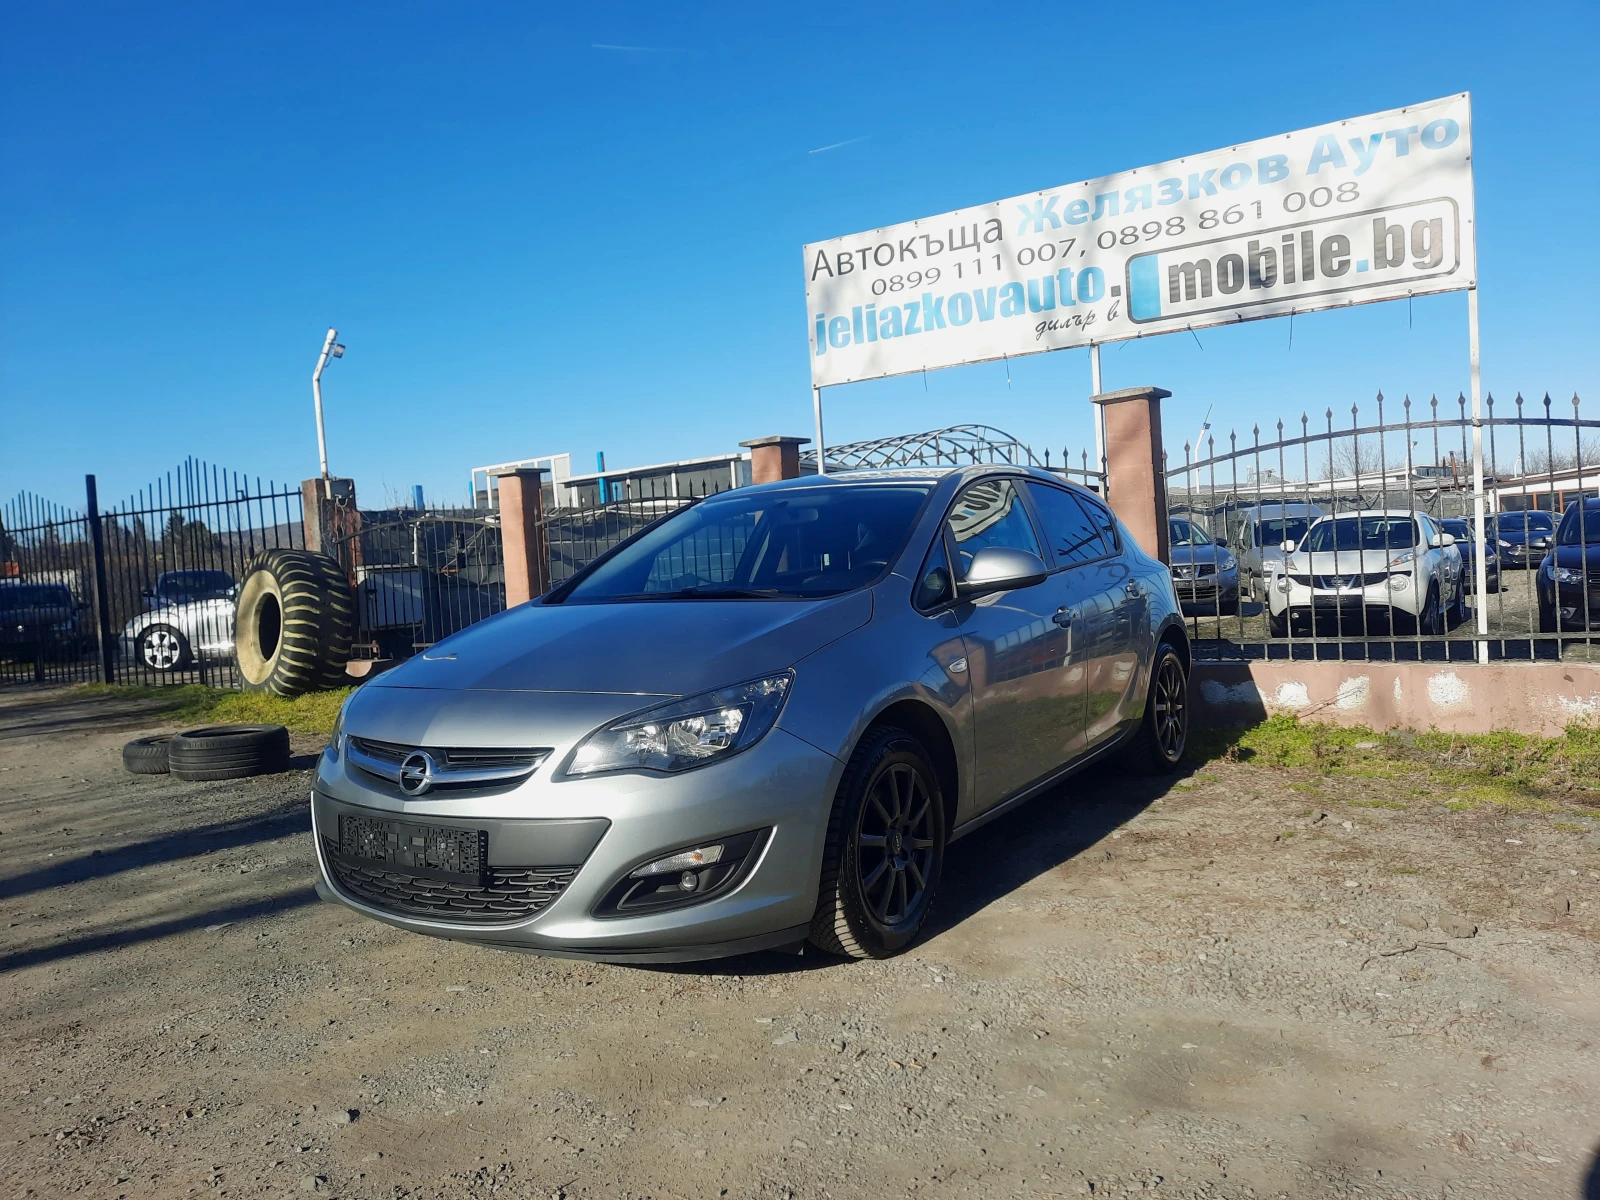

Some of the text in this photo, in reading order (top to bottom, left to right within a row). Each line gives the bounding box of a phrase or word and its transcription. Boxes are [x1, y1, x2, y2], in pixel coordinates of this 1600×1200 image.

[811, 118, 1459, 281] Автокъща Желязков Ауто
[871, 181, 1360, 295] 0899 111 007, 0898 861 008
[1168, 217, 1443, 303] mobile.bg
[1035, 309, 1098, 341] дилър
